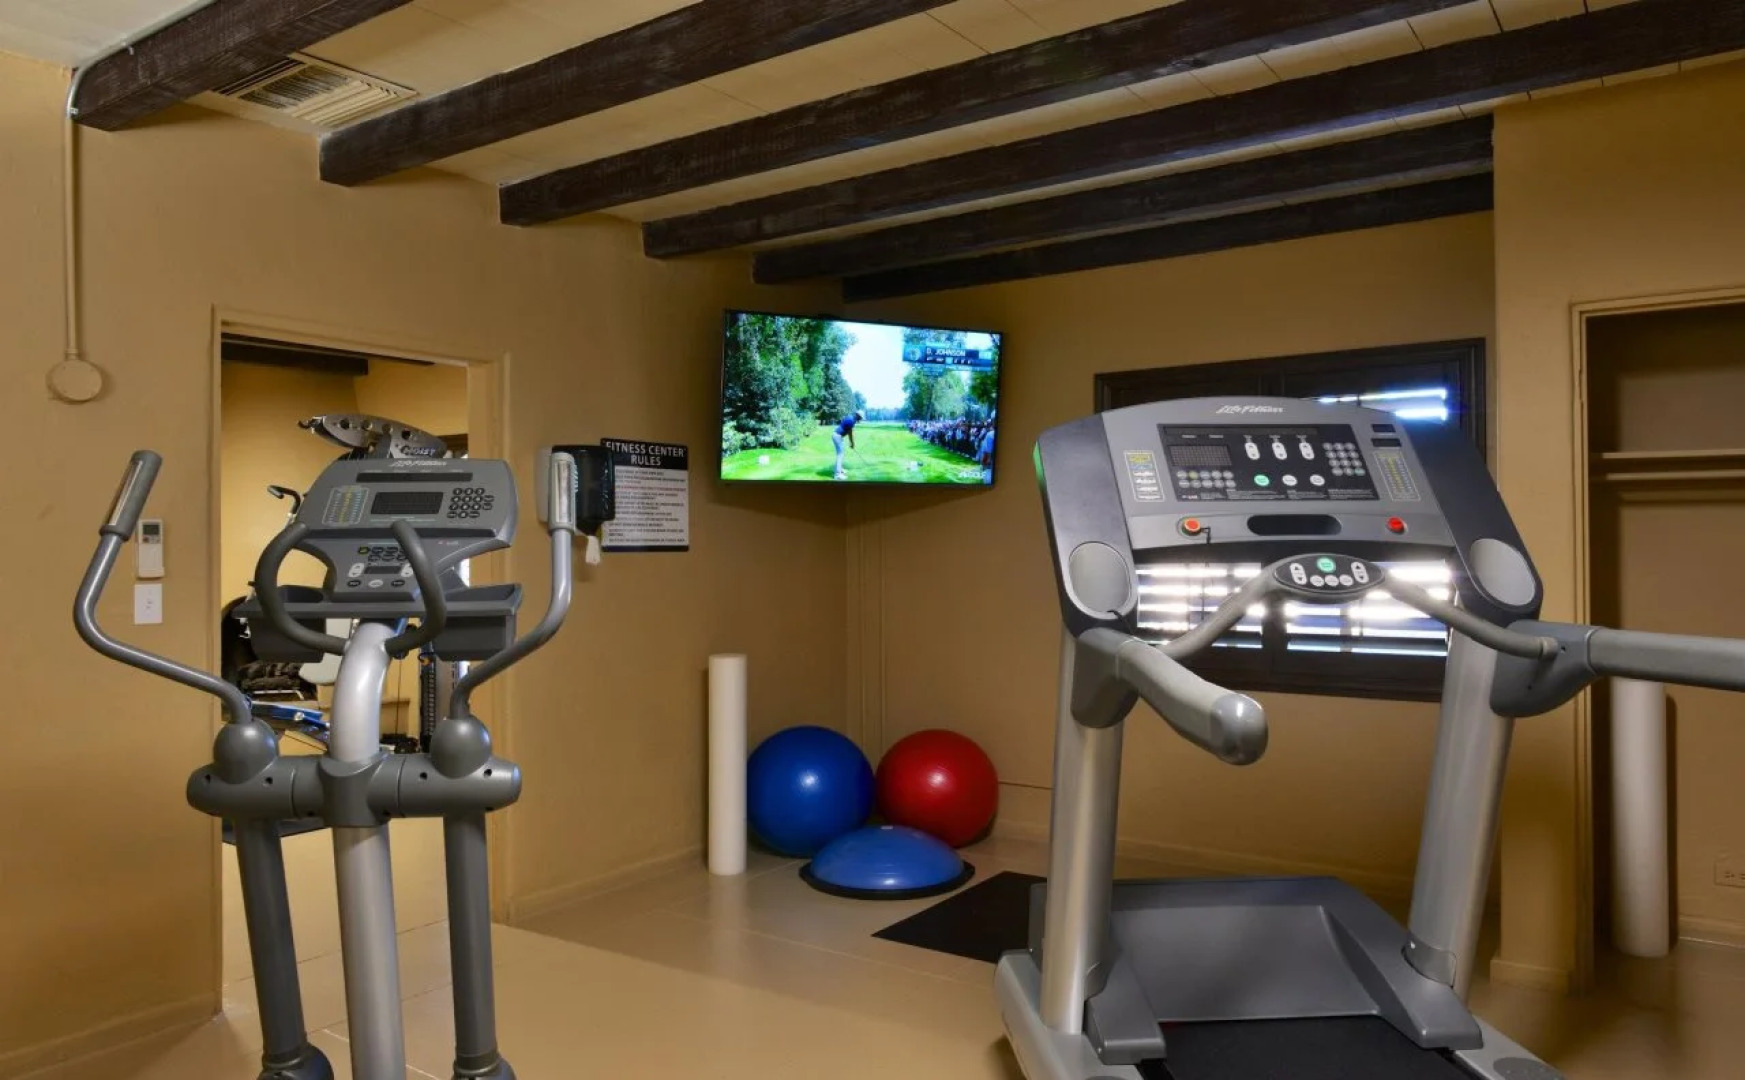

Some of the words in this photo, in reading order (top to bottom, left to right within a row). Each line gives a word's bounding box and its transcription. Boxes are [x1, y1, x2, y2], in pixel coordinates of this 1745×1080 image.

[935, 348, 966, 357] JOHNSON
[648, 445, 684, 457] CENTER
[630, 454, 661, 466] RULES
